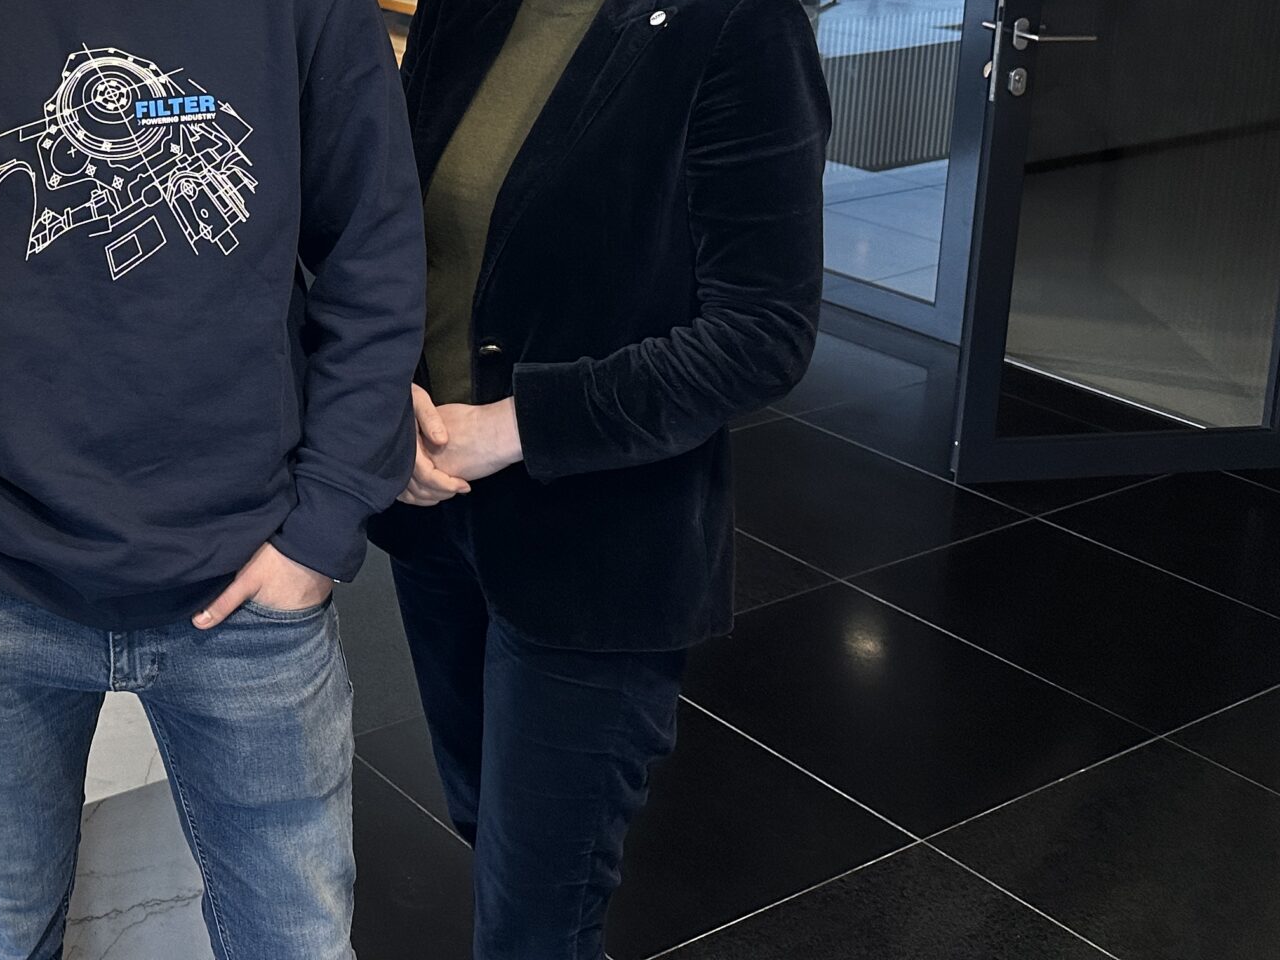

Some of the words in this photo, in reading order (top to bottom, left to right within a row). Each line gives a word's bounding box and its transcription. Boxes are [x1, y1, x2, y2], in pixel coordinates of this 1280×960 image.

[135, 95, 216, 119] FILTER
[141, 117, 179, 125] POWERING
[180, 113, 216, 121] INDUSTRY
